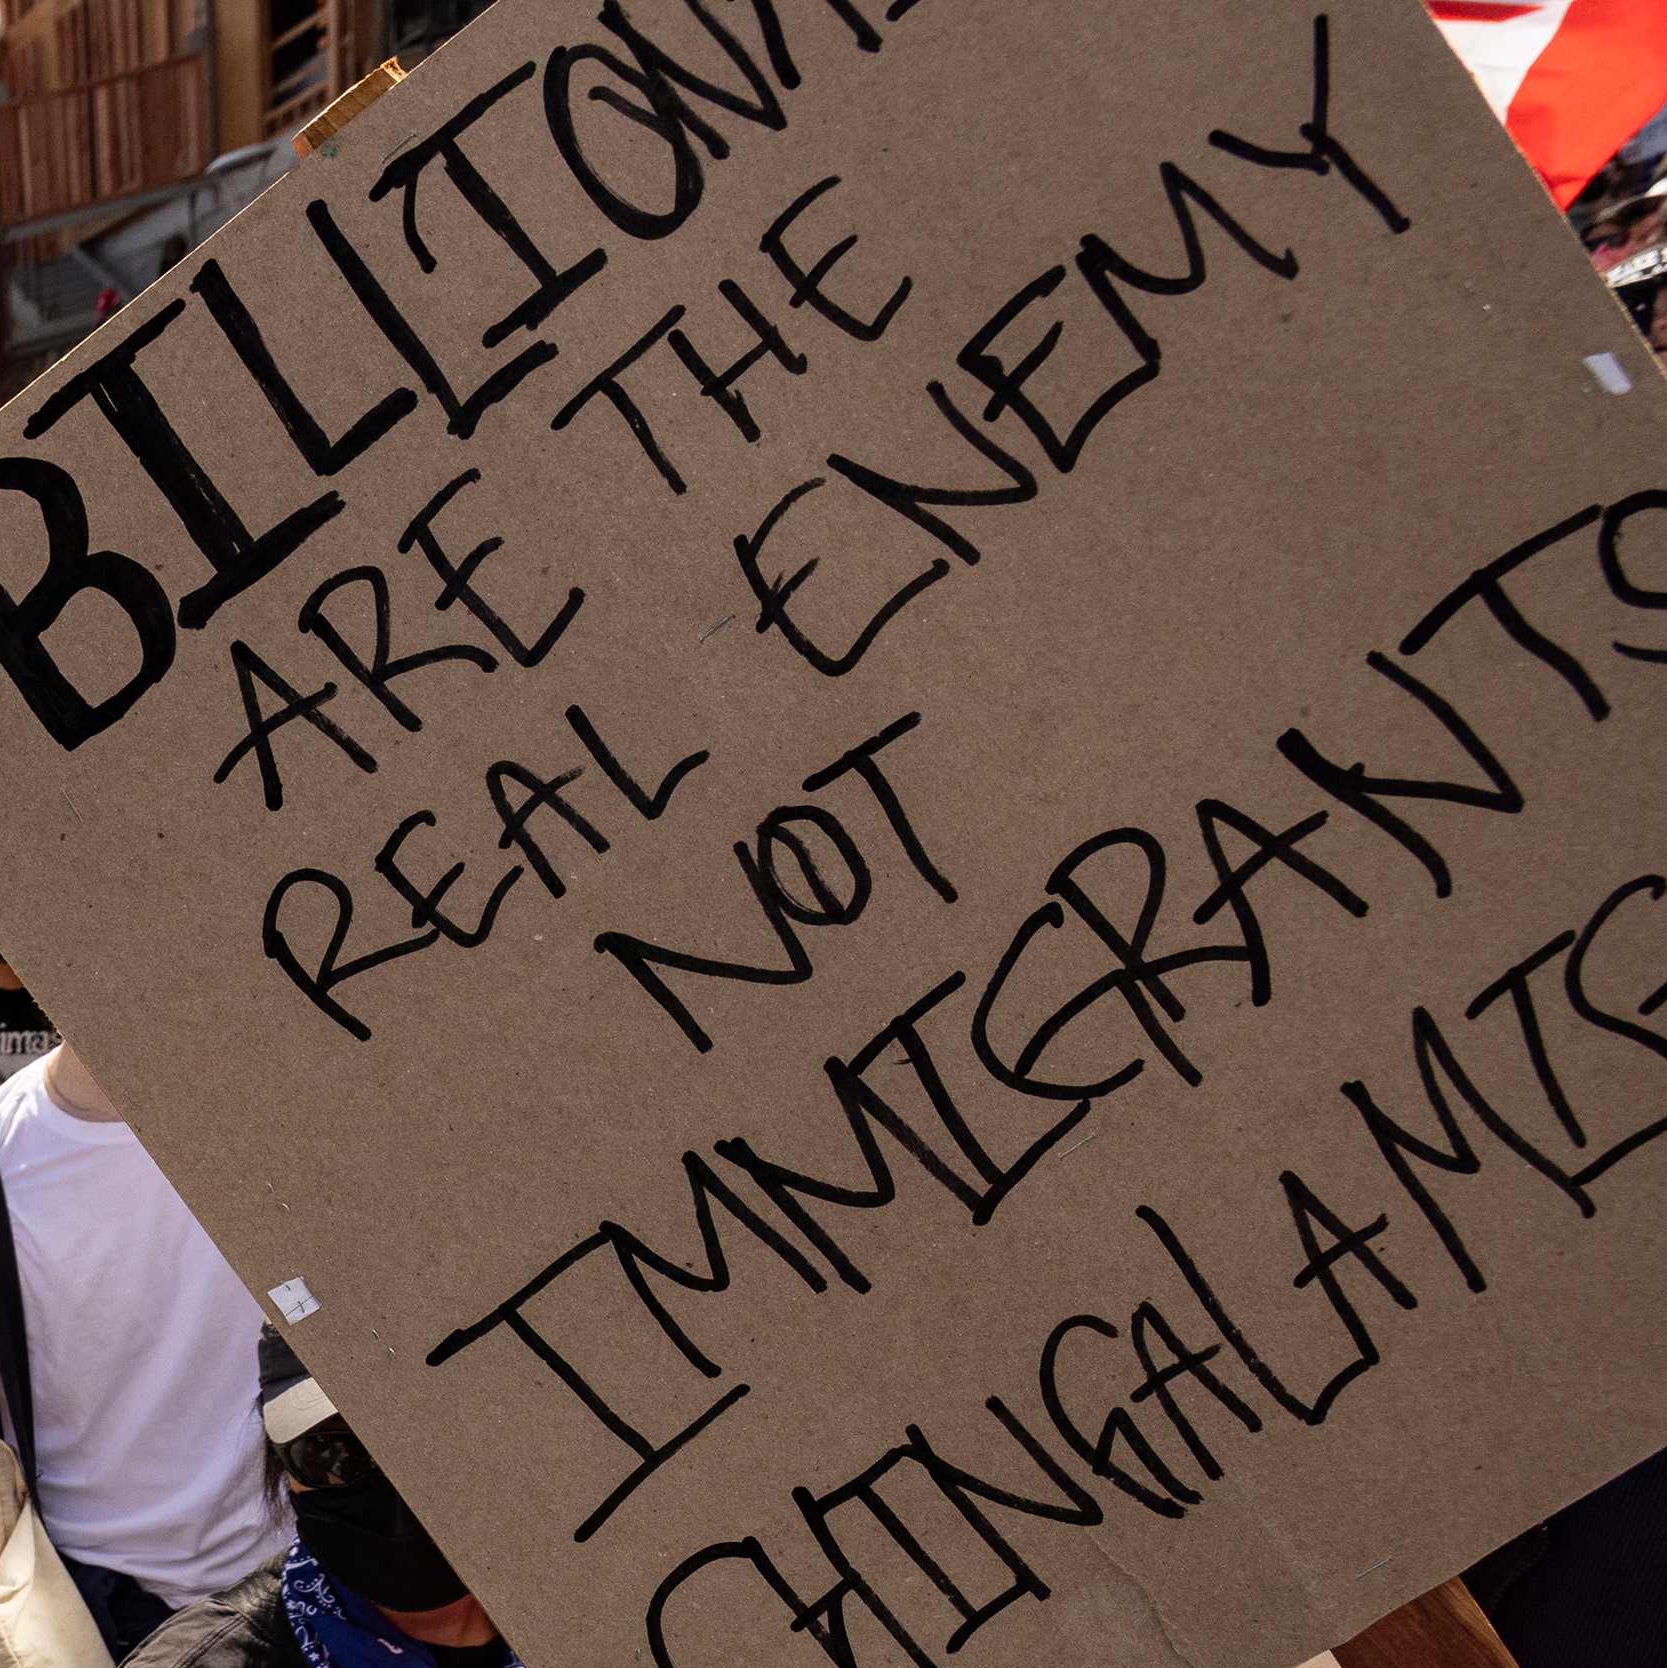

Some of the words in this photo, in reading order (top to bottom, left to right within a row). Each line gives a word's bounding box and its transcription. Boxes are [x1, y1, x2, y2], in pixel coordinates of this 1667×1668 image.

[213, 465, 586, 809] ARE
[551, 175, 913, 494] THE
[262, 704, 710, 1041] REAL
[733, 13, 1411, 676] ENEMY
[594, 711, 959, 1052] NOT
[425, 488, 1667, 1542] IMMIGRANTS
